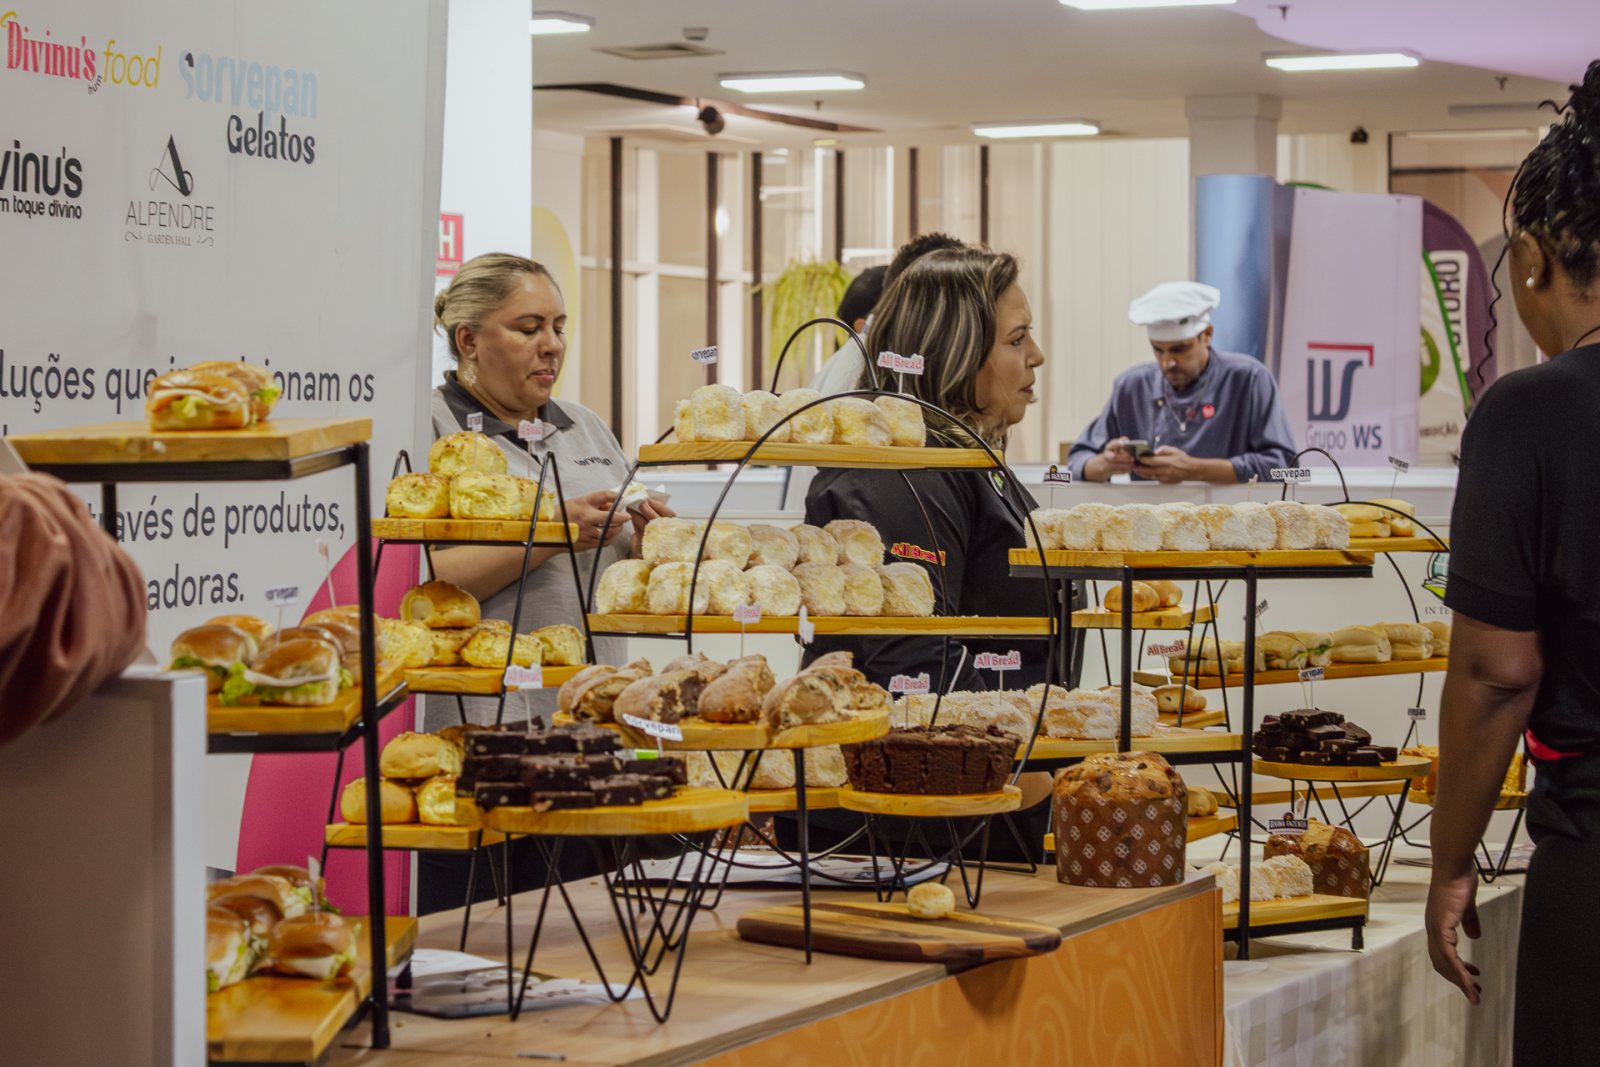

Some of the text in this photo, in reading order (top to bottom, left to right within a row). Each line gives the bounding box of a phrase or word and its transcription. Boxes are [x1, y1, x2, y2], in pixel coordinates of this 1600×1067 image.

[6, 20, 162, 88] Divinu's food
[178, 50, 318, 128] sorvepan
[227, 110, 315, 165] Gelatos
[13, 195, 46, 219] toque
[49, 200, 83, 220] divino
[125, 200, 215, 231] ALPENDRE
[880, 353, 921, 370] All Bread
[349, 371, 375, 403] os
[1305, 424, 1382, 451] Grupo WS
[1271, 467, 1311, 482] sorvepan
[183, 492, 216, 538] de
[225, 490, 345, 549] produtos,
[891, 542, 910, 557] All
[976, 652, 1019, 667] All Bread
[891, 677, 928, 690] All Bread
